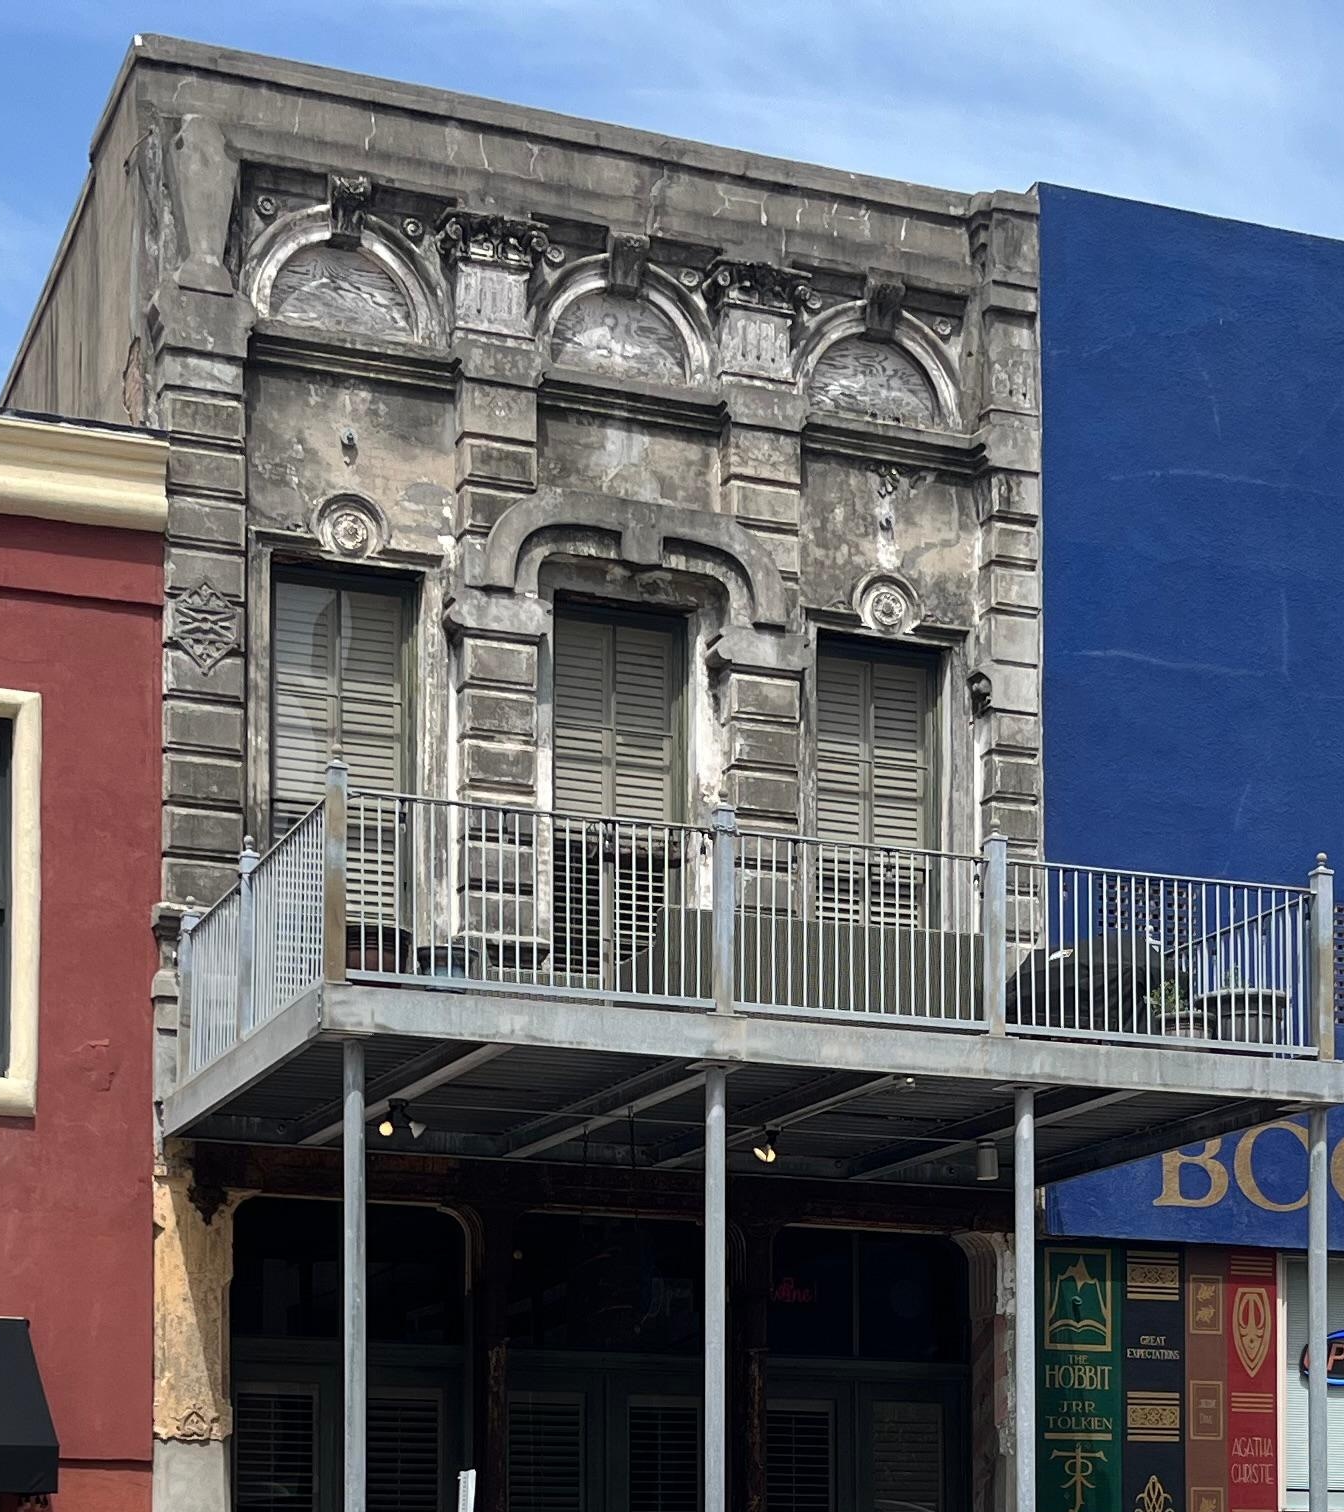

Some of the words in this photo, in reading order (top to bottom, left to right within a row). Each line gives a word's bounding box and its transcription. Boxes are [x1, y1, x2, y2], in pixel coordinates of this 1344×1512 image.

[1139, 1335, 1167, 1346] GREAT
[1068, 1354, 1089, 1364] THE
[1126, 1348, 1181, 1360] EXPECTATIONS
[1045, 1365, 1113, 1390] HOBBIT
[1045, 1415, 1113, 1431] TOLKIEN
[1231, 1436, 1274, 1458] AGATHA
[1231, 1463, 1275, 1485] CHRISTIE
